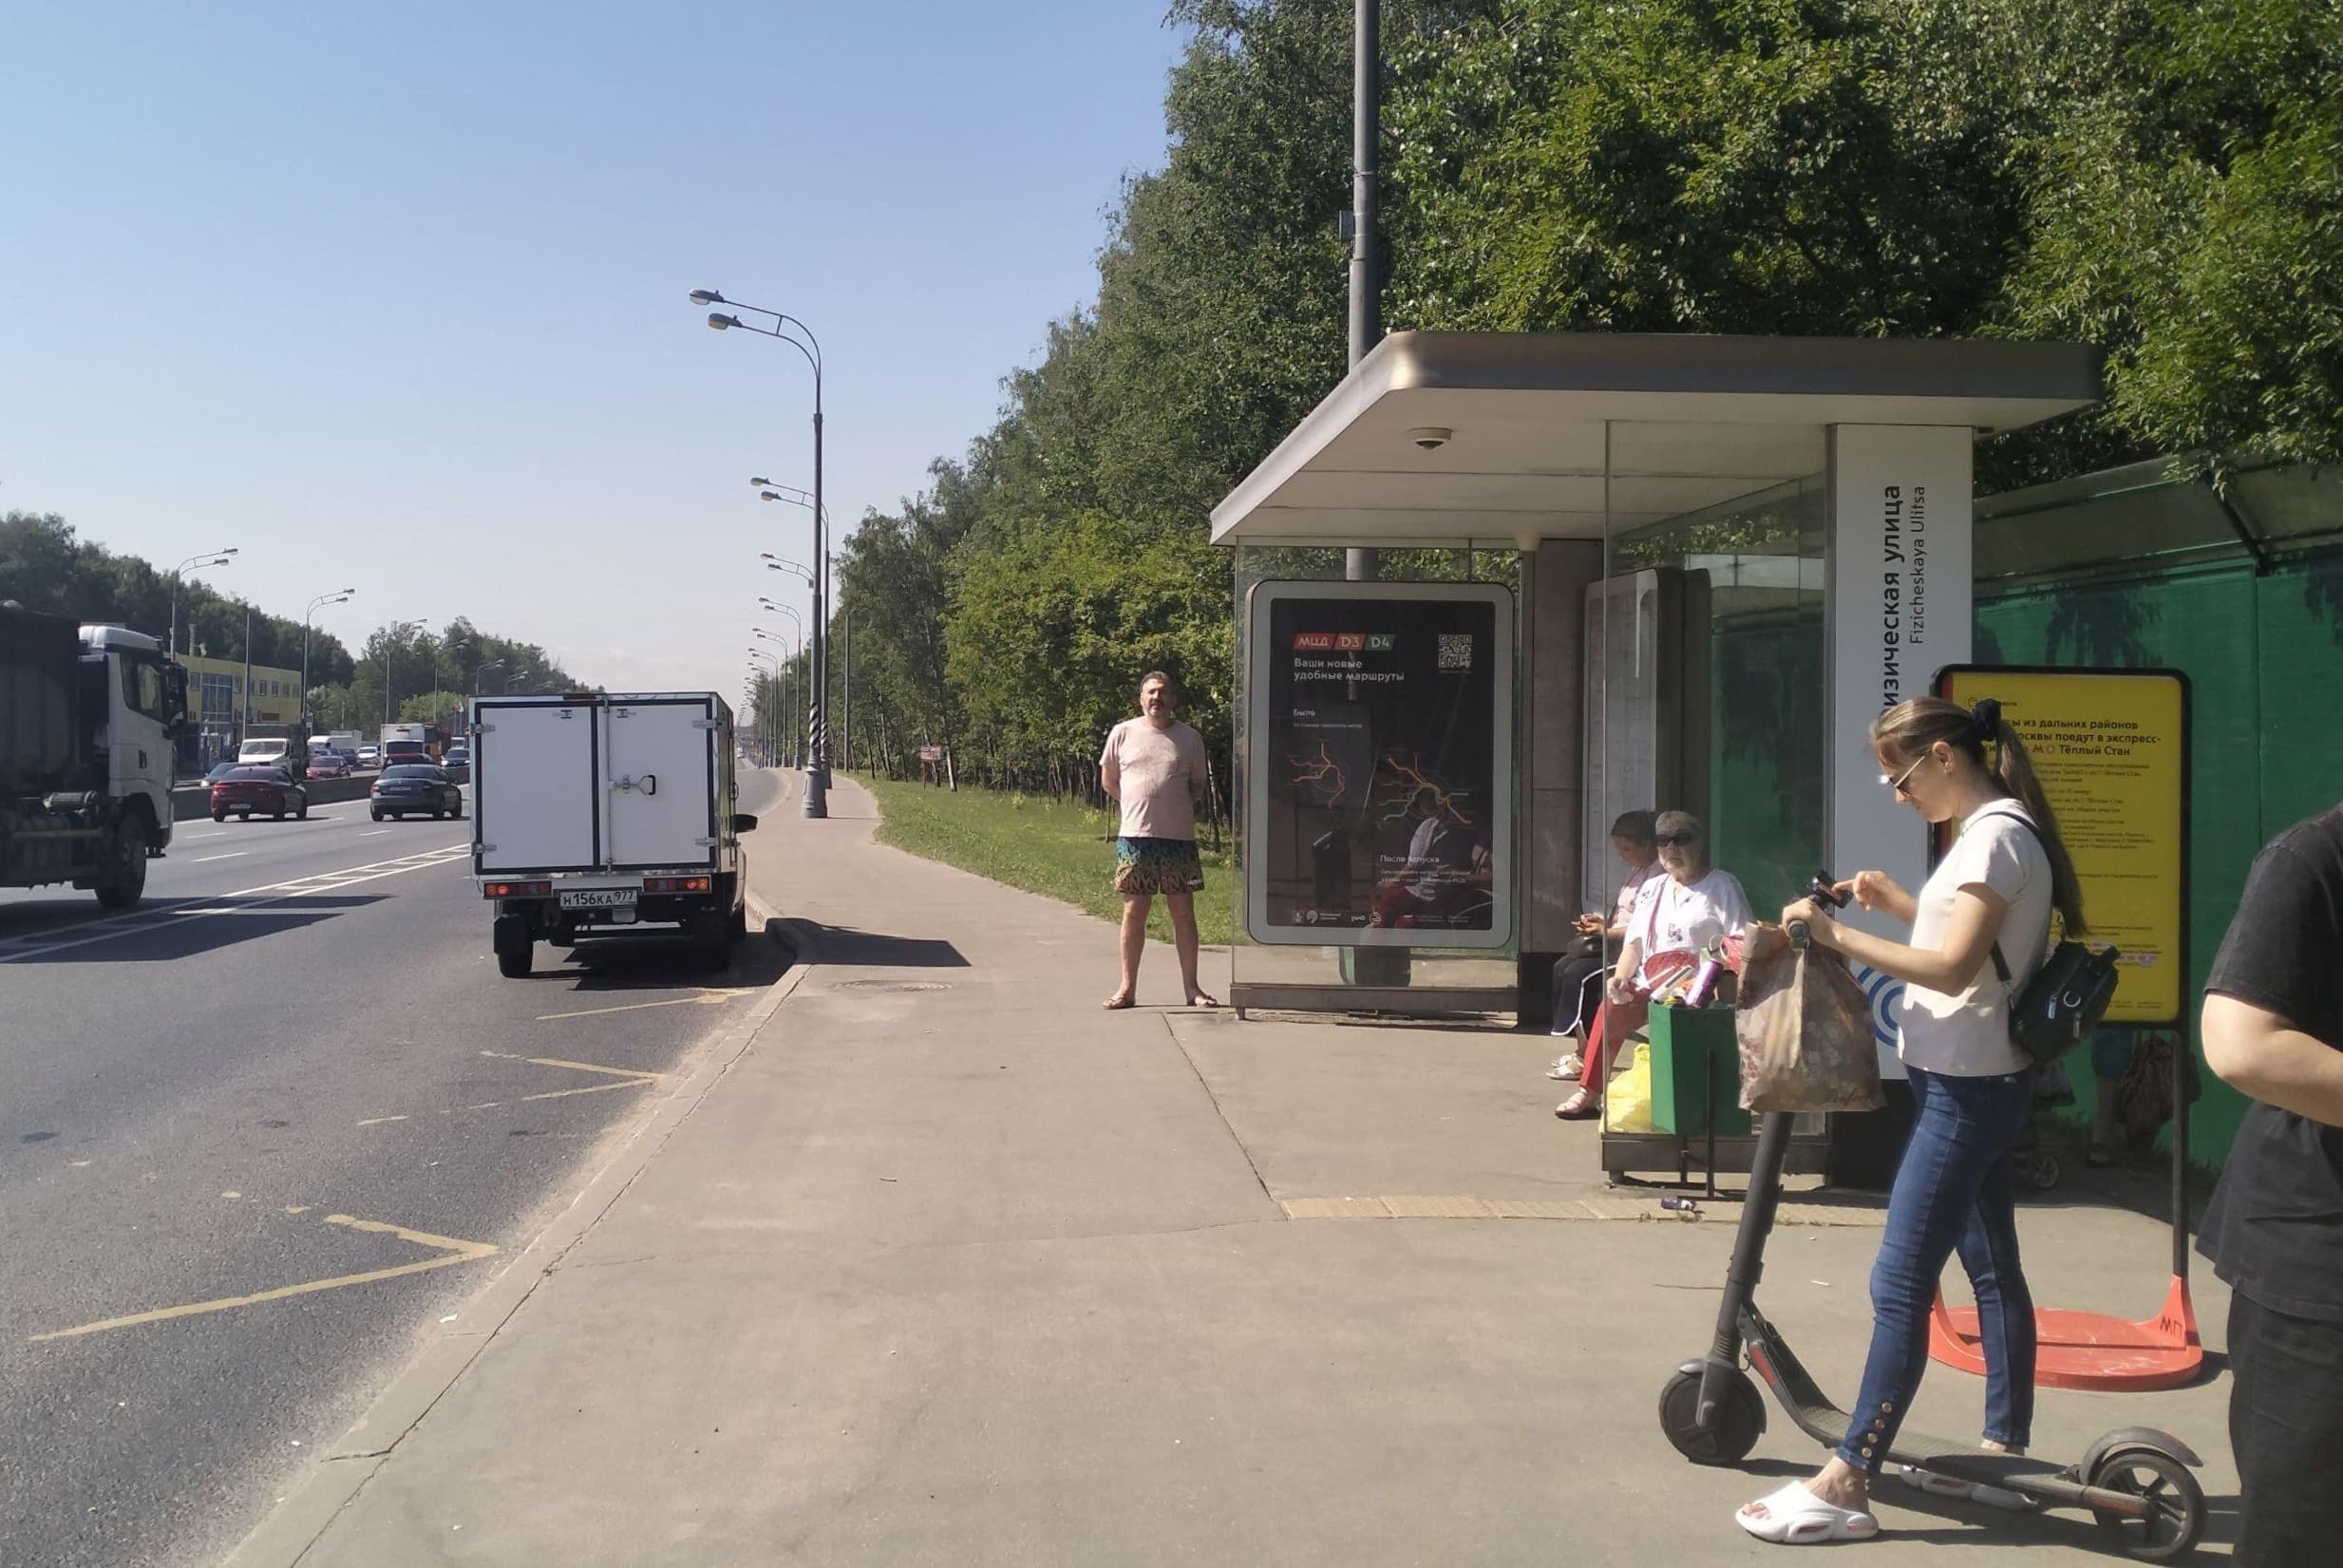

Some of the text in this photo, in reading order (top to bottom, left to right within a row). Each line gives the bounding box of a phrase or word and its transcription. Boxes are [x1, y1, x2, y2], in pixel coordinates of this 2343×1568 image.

[1909, 486, 1928, 644] Fizicheskaya Ulitsa
[1881, 485, 1905, 714] изическая улица
[1340, 636, 1360, 647] D3
[1370, 636, 1389, 648] D4
[1294, 657, 1362, 669] Ваши новые
[1294, 670, 1405, 683] удобные маршруты
[2039, 720, 2087, 729] дальних
[2089, 720, 2138, 731] районов
[2055, 733, 2095, 744] поедут
[2107, 734, 2162, 746] экспресс-
[2059, 745, 2102, 755] Тёплый
[2104, 746, 2130, 756] Стан
[614, 891, 633, 900] 977
